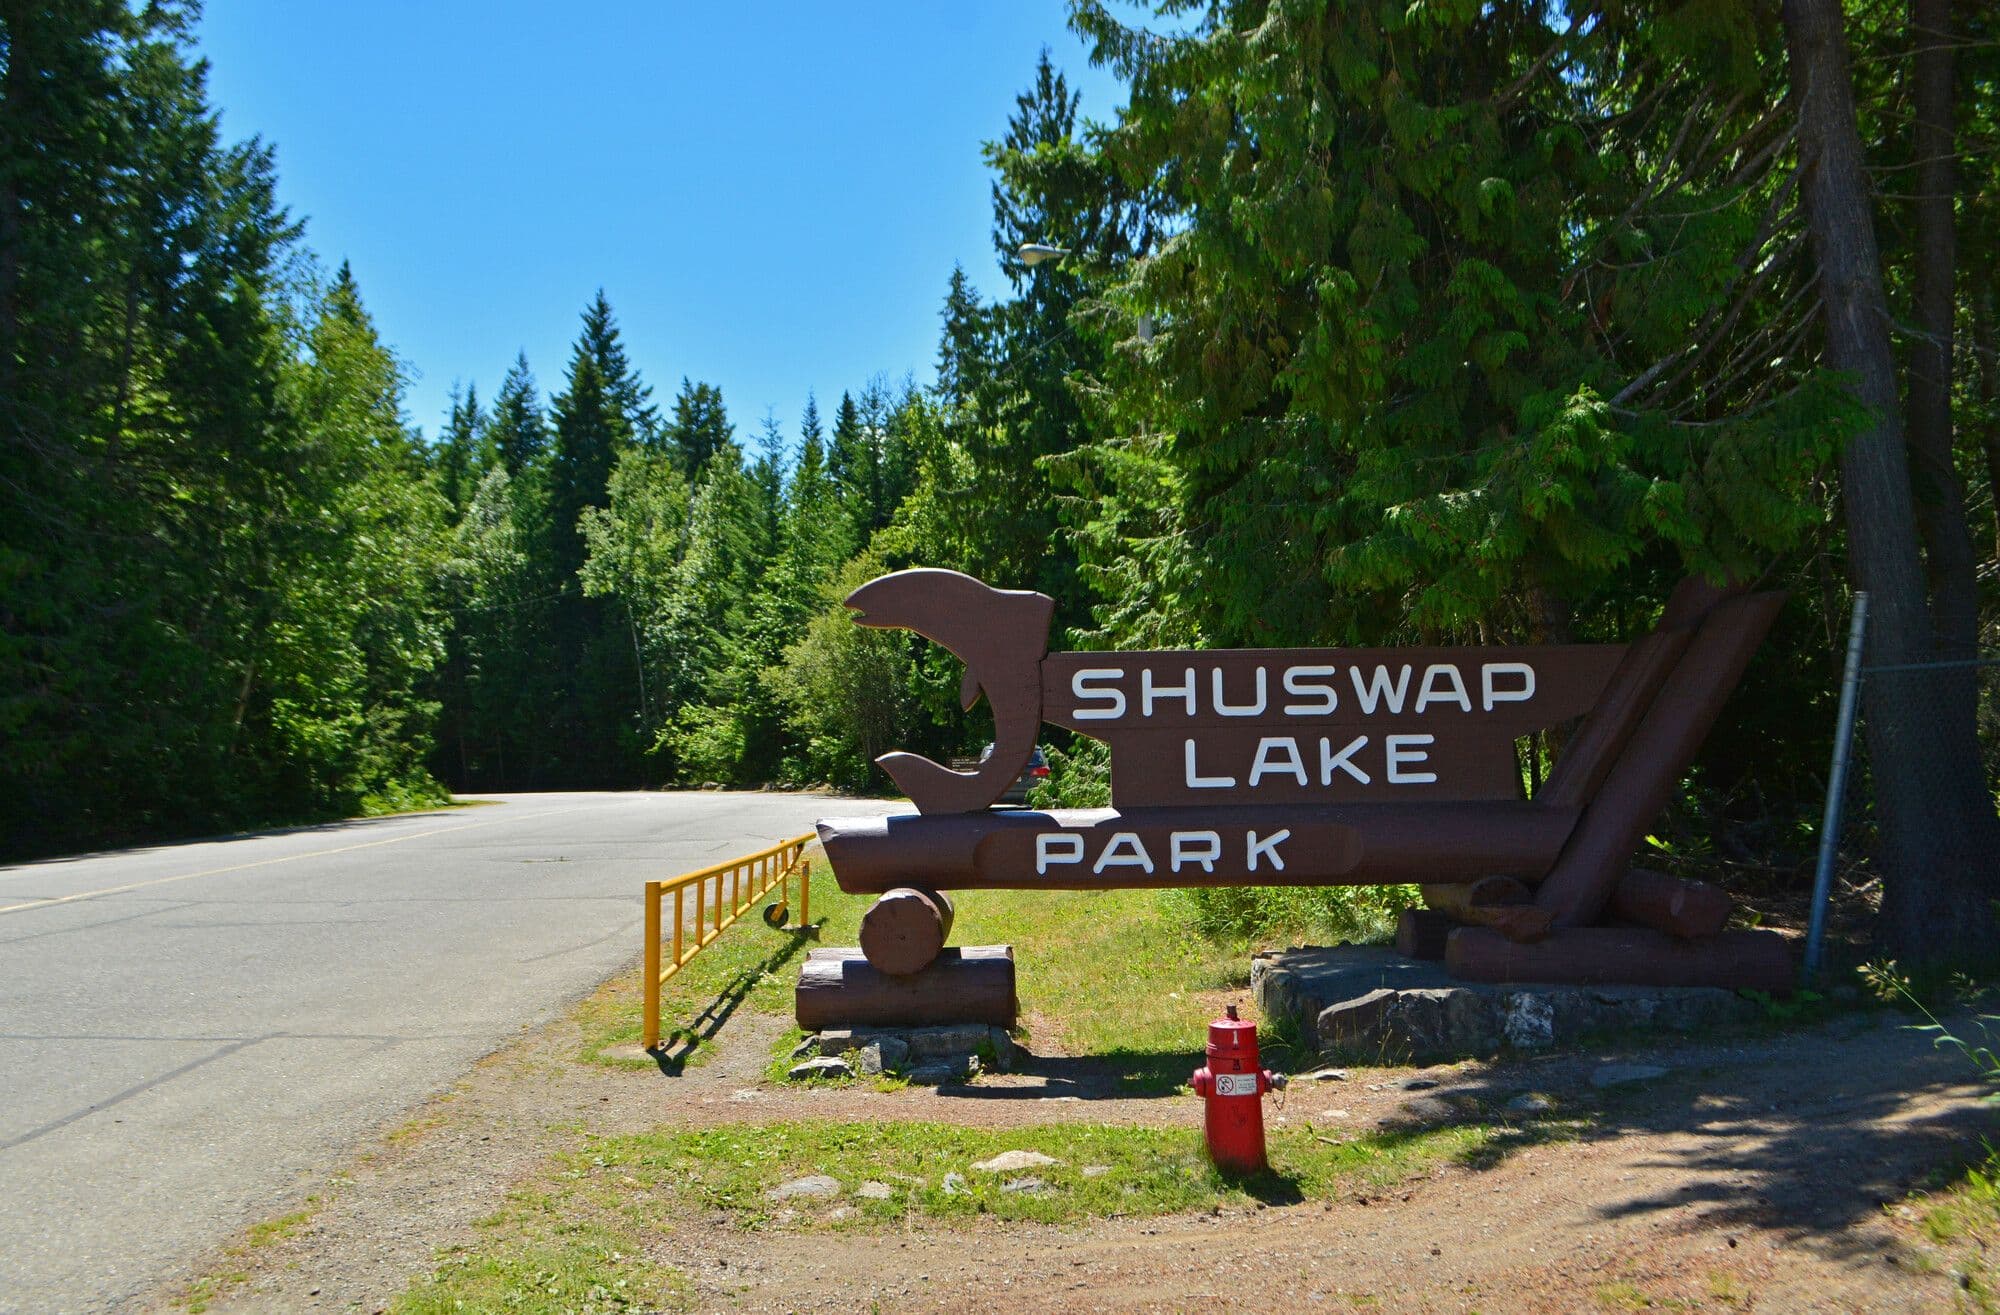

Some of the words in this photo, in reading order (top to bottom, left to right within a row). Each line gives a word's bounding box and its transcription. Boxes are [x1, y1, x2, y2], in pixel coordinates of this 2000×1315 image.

[1071, 662, 1536, 720] SHUSWAP
[1184, 734, 1437, 788] LAKE
[1035, 830, 1291, 874] PARK
